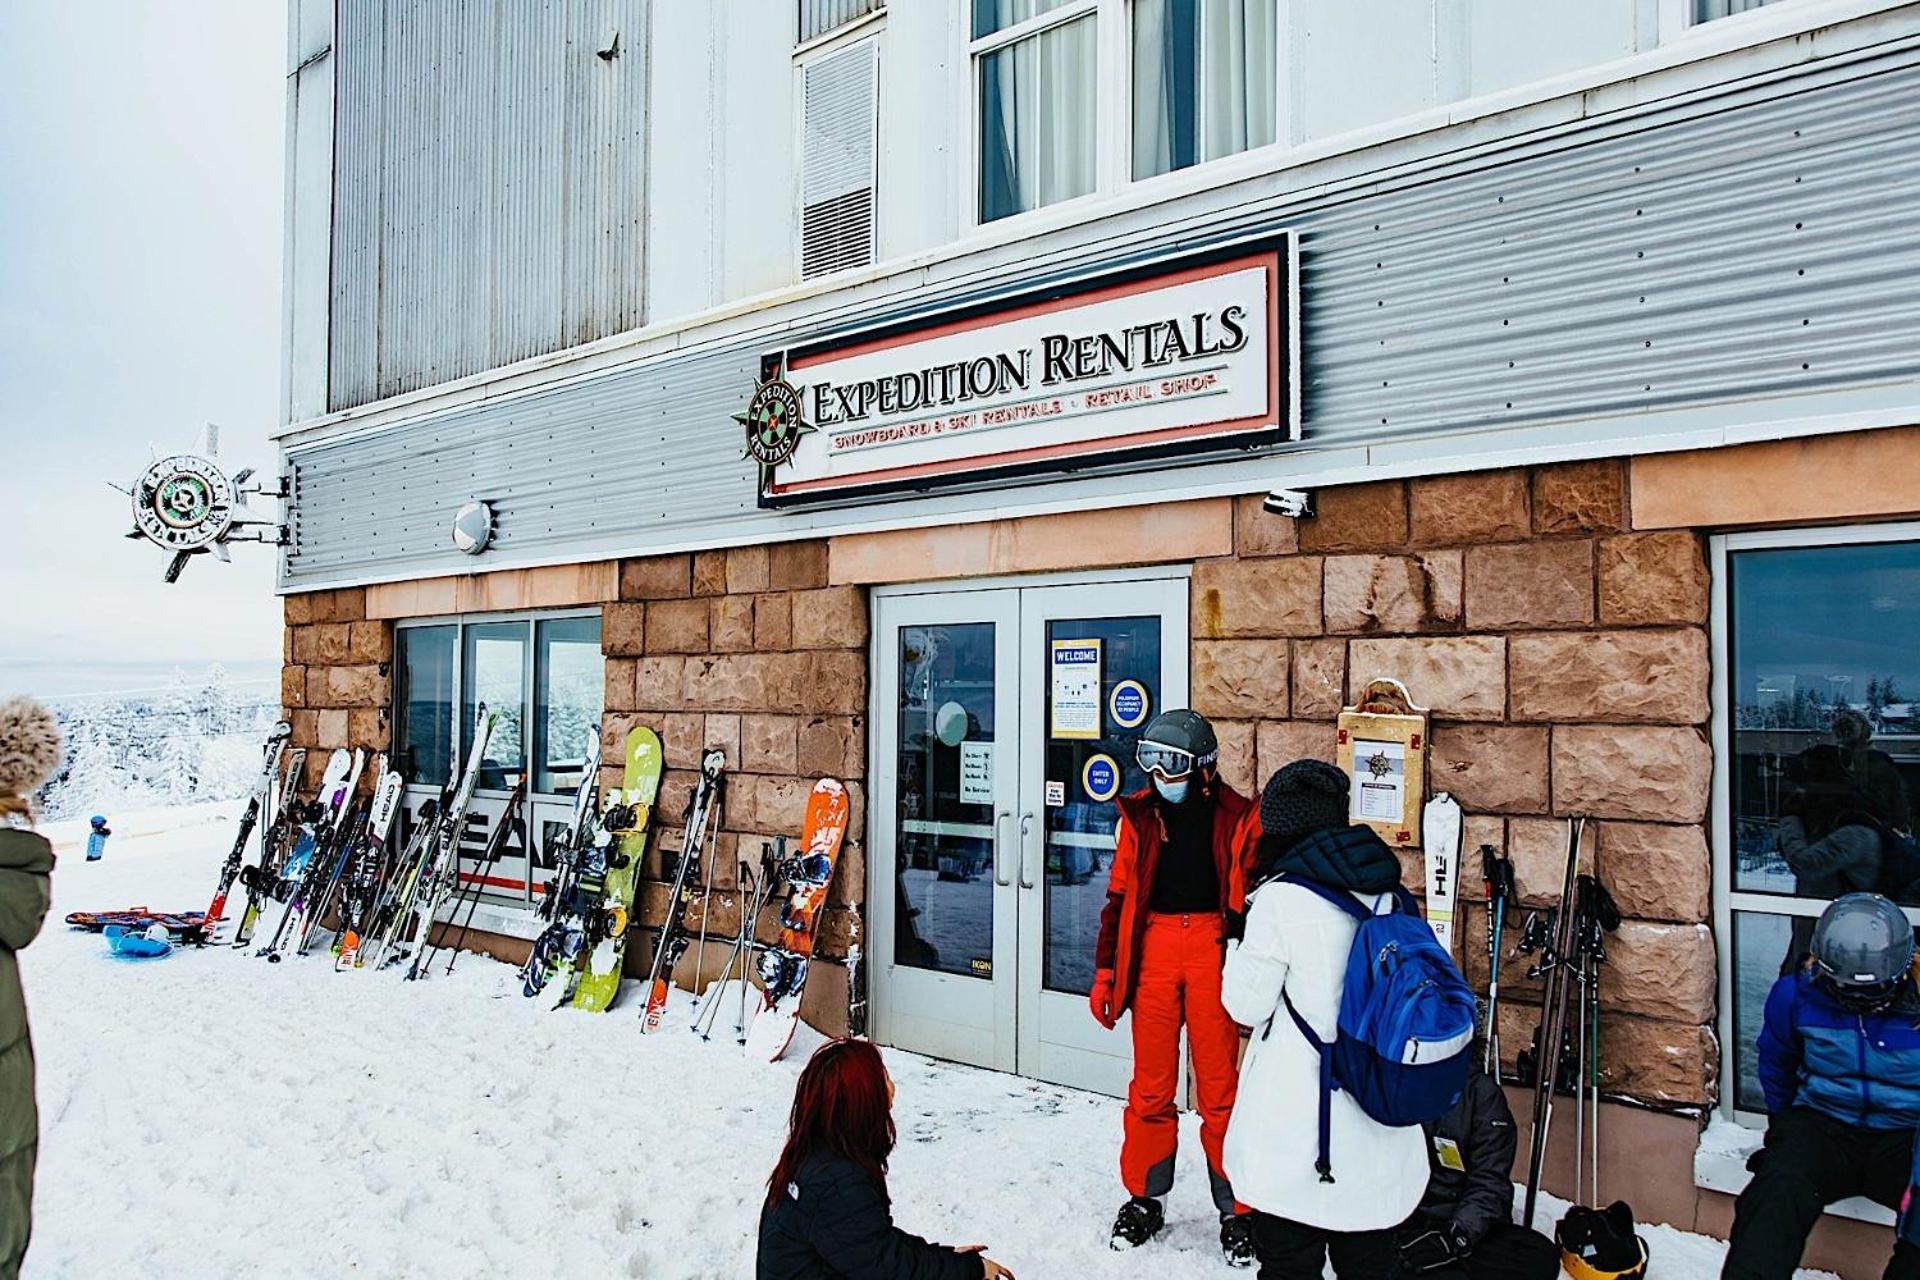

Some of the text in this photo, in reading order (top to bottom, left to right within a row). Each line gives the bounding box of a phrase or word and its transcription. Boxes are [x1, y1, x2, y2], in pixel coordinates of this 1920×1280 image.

[812, 305, 1248, 426] EXPEDITION RENTALS
[751, 386, 797, 428] EXPEDITION
[835, 373, 1217, 448] SNOWBOARD & SKI RENTALS RETAIL SHOP
[750, 433, 791, 460] RENTALS
[1056, 650, 1097, 662] WELCOME
[380, 784, 395, 822] HEAD
